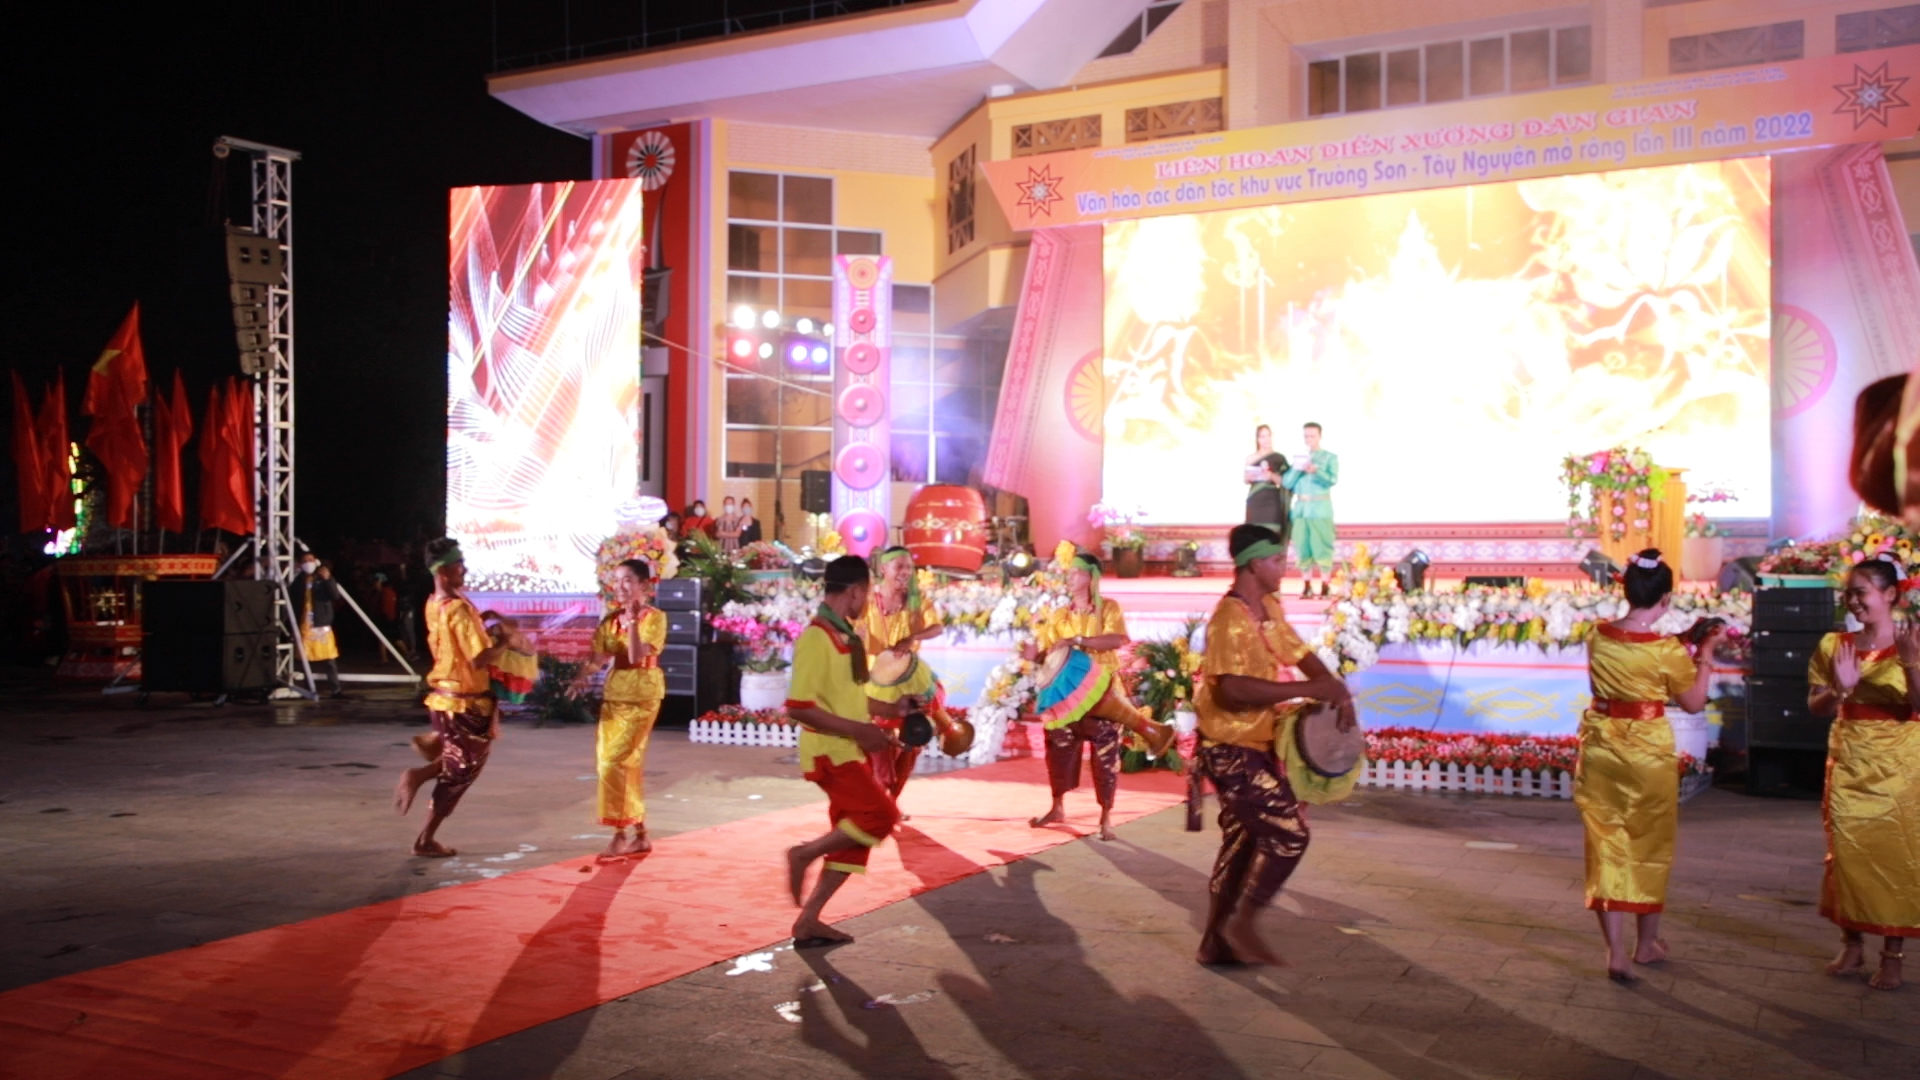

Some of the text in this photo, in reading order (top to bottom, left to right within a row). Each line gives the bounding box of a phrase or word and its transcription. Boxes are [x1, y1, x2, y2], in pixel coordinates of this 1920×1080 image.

[1229, 147, 1311, 171] HOAN
[1605, 101, 1697, 127] GIAN
[1240, 175, 1270, 196] khu
[1462, 145, 1536, 176] Nguyên
[1672, 126, 1693, 148] III
[1754, 112, 1812, 140] 2022
